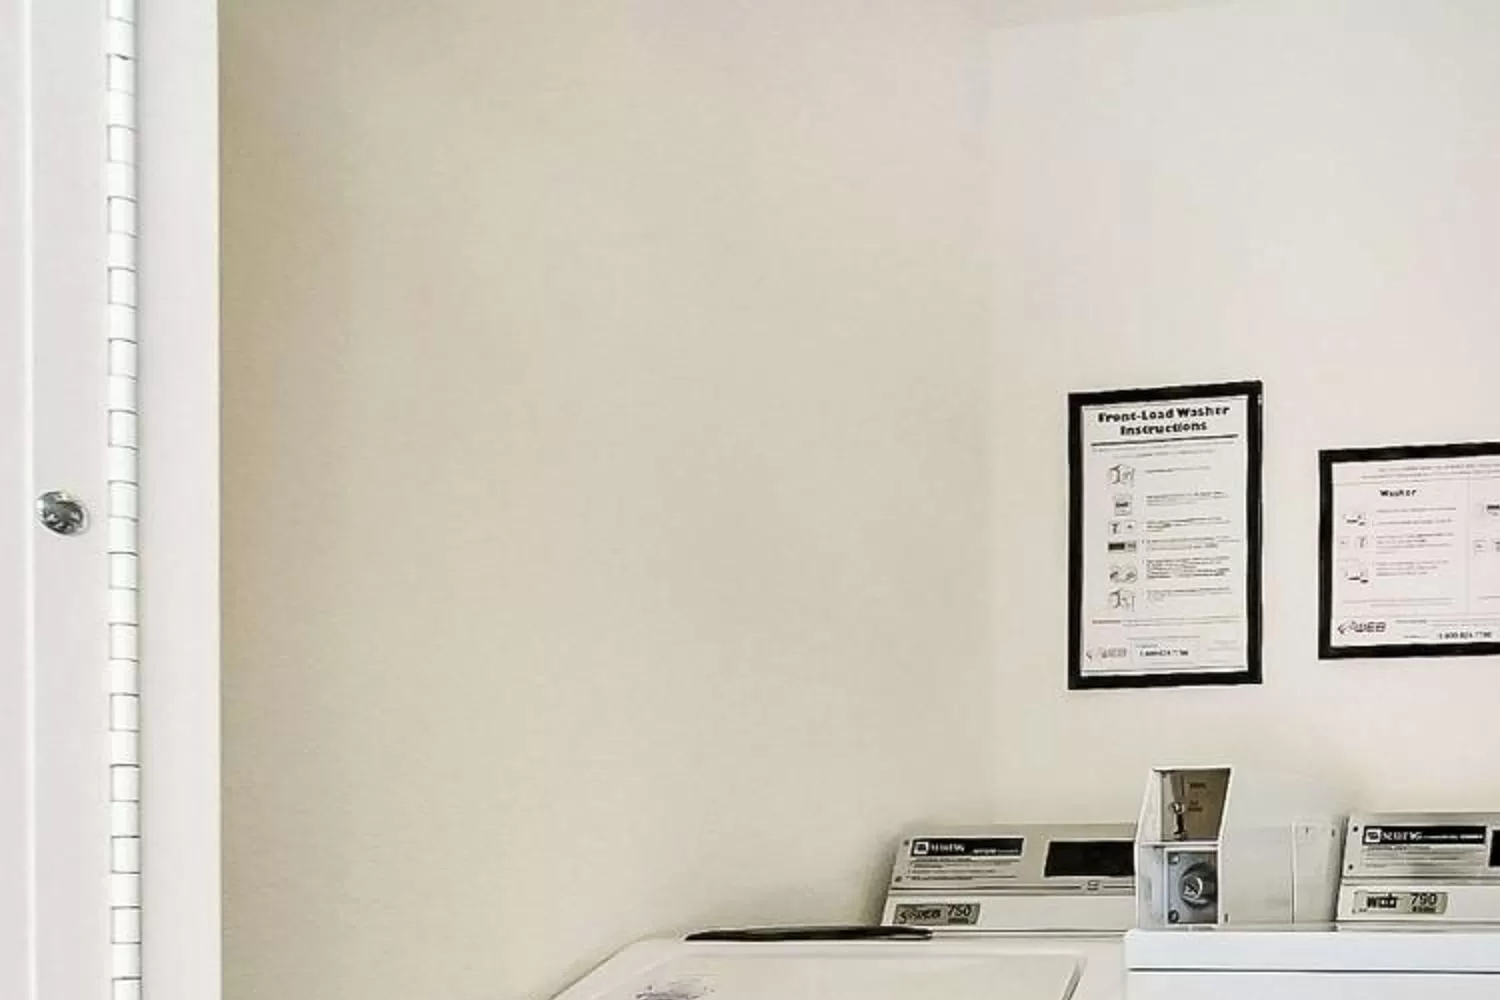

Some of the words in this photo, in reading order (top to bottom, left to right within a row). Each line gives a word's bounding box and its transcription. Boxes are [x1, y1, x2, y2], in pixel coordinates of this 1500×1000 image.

[1098, 408, 1175, 423] Front-Load
[1176, 405, 1231, 419] Washer
[1120, 421, 1208, 436] Instructions
